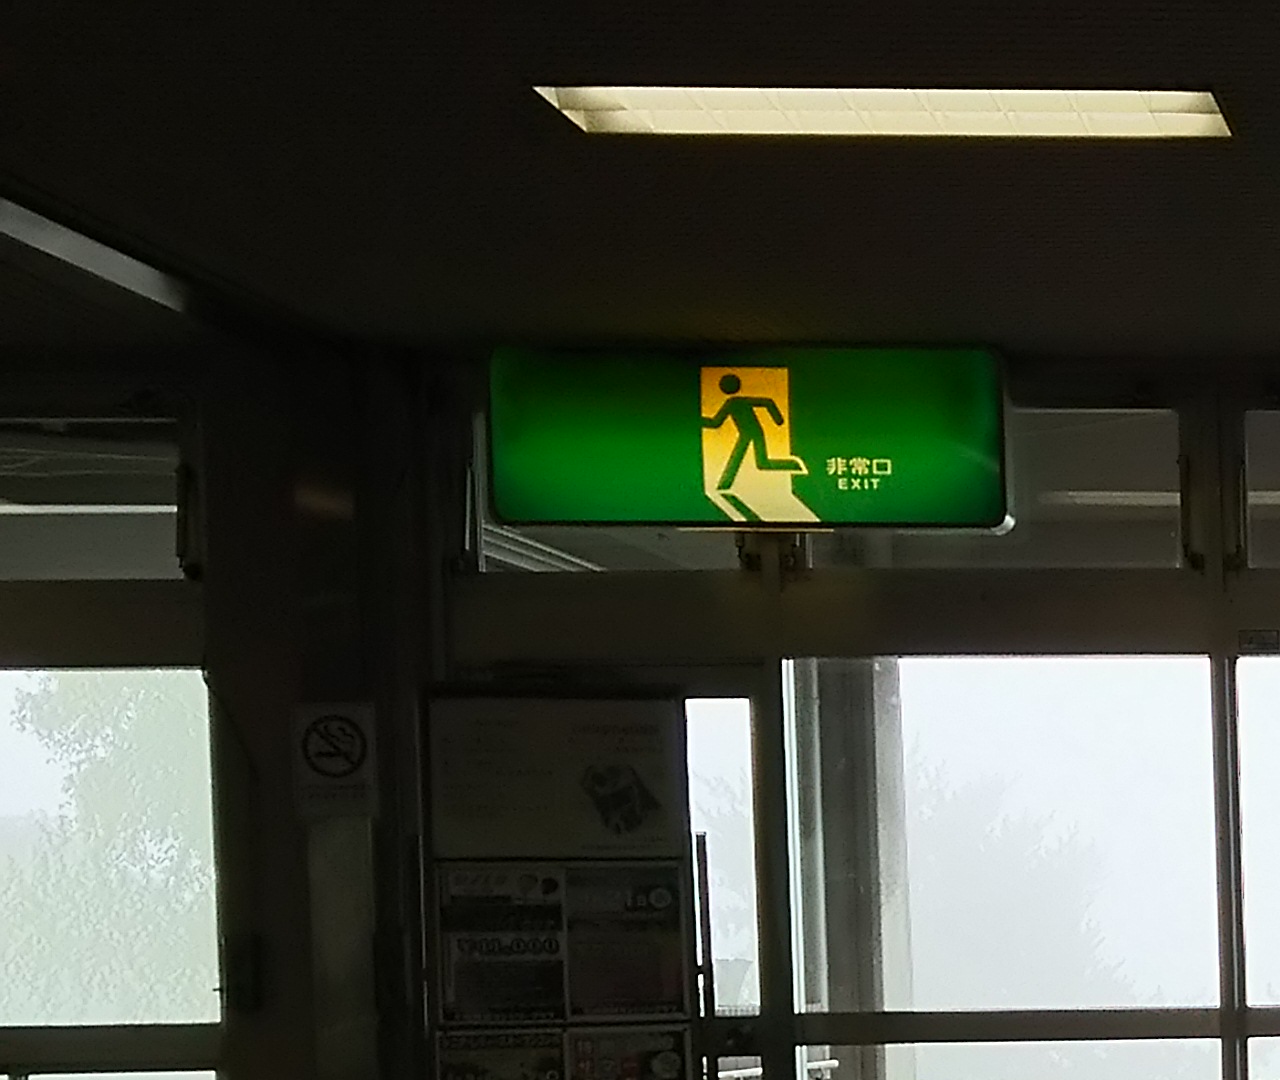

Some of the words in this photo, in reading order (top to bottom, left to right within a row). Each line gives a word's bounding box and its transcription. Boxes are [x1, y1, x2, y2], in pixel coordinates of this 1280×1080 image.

[826, 457, 892, 476] 非常口
[838, 478, 880, 490] EXIT
